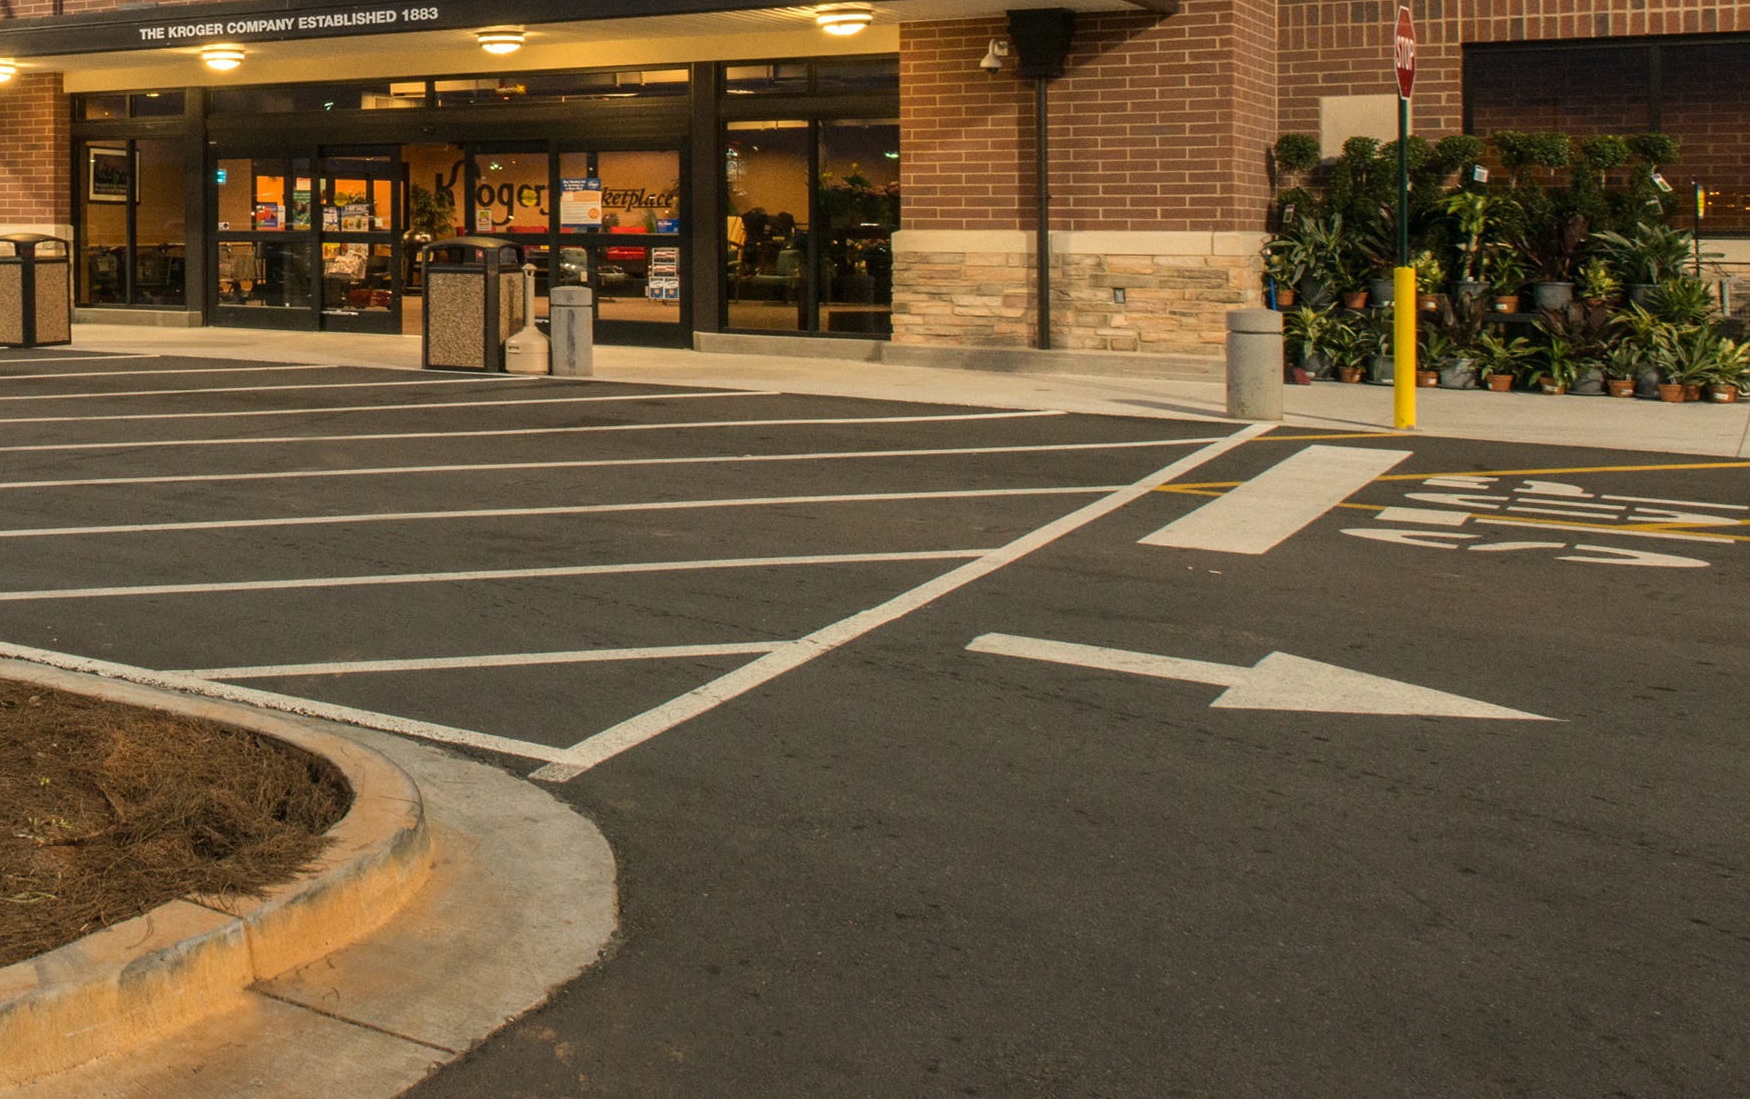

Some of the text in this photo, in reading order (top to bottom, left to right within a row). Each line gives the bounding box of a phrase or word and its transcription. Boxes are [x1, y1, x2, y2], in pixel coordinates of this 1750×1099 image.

[139, 7, 438, 40] THE KROGER COMPANY ESTABLISHED 1883
[1396, 35, 1414, 71] STOP
[436, 160, 546, 226] Koger
